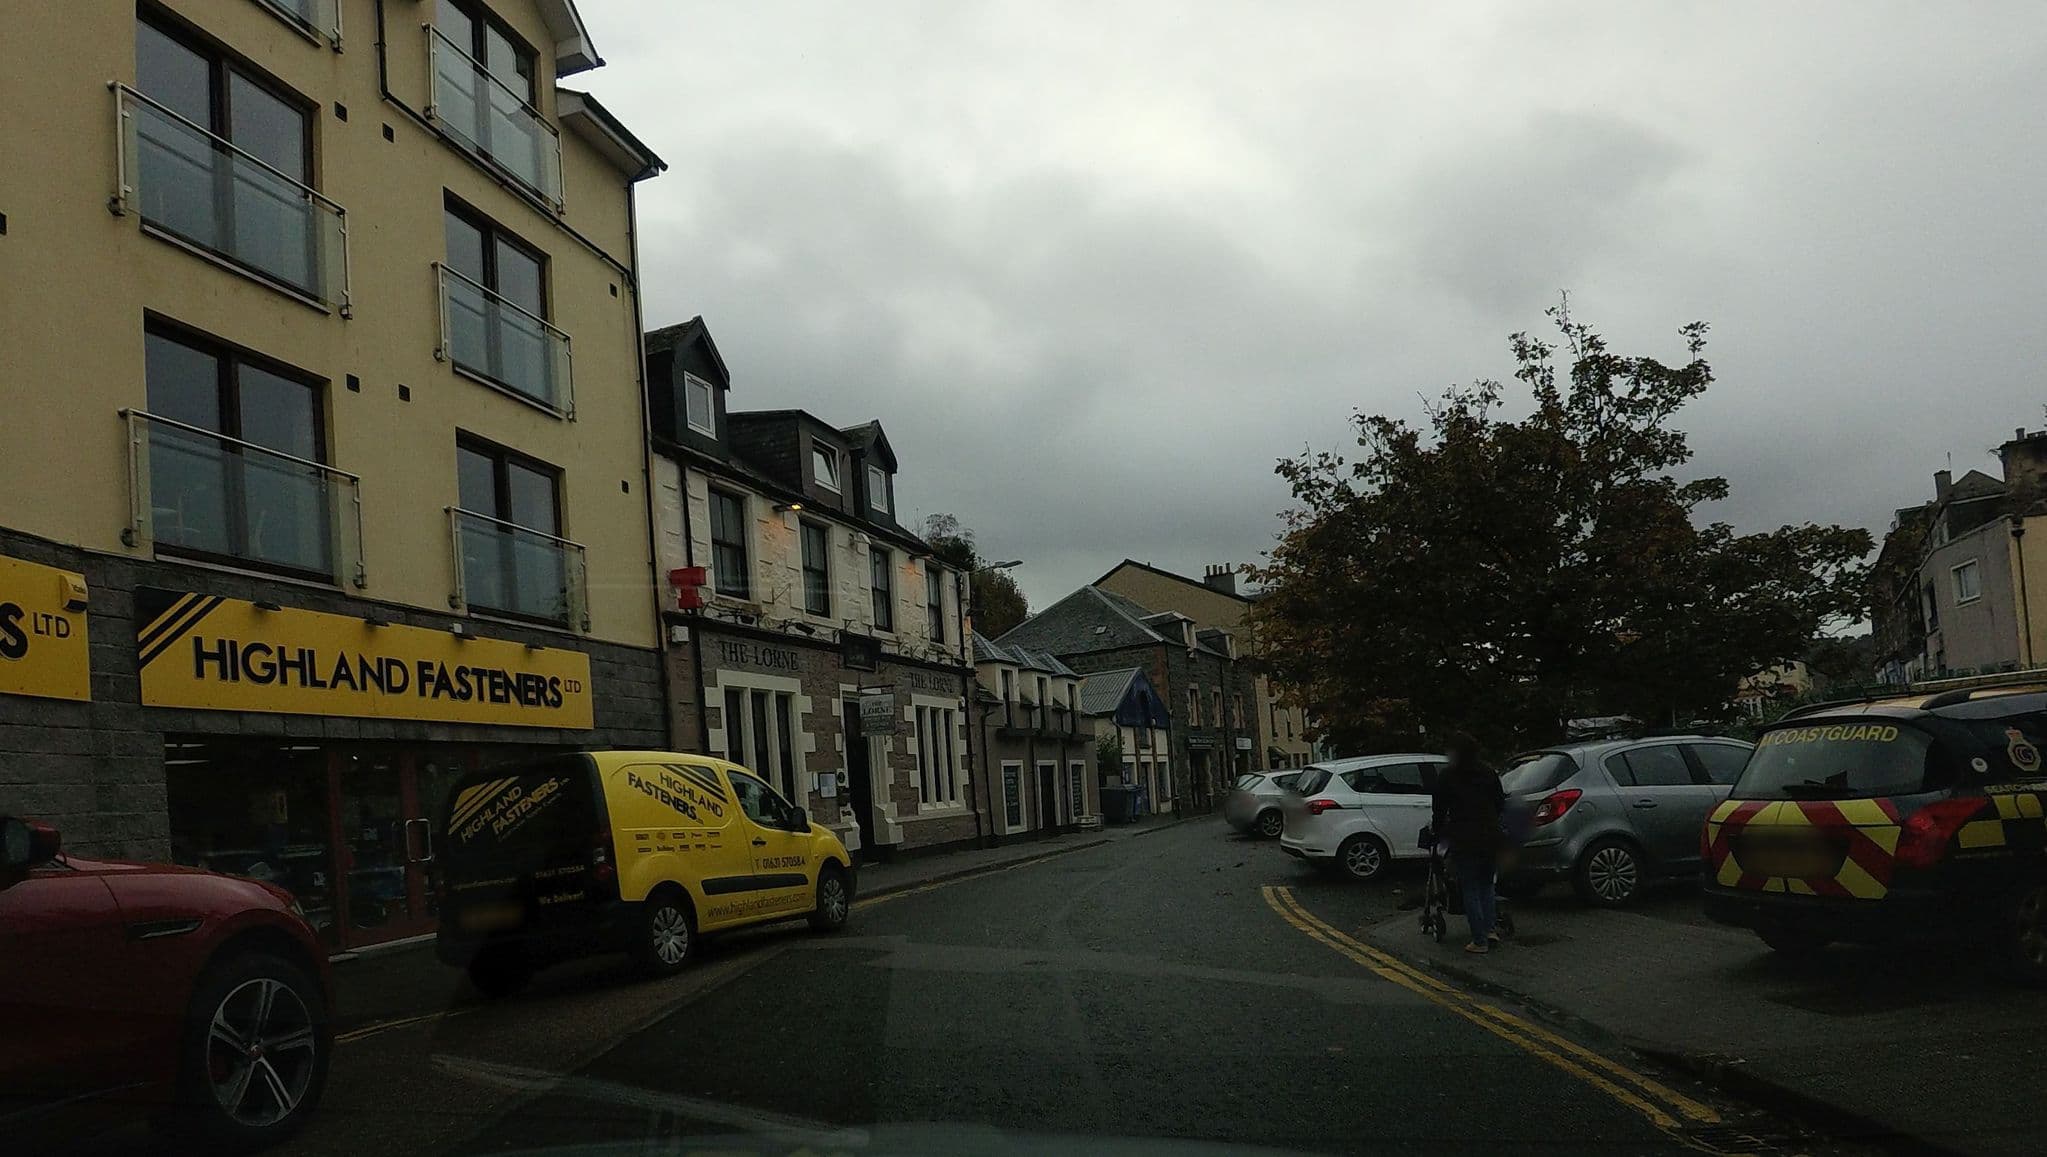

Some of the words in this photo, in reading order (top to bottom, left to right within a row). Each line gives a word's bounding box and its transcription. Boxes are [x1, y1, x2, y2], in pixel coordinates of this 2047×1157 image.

[33, 612, 70, 638] LTD
[193, 636, 409, 695] HIGHLAND
[417, 660, 563, 708] FASTENERS
[564, 679, 582, 693] LTD
[719, 641, 748, 664] THE
[754, 646, 799, 671] LORNE
[1774, 725, 1899, 746] COASTGUARD
[459, 785, 523, 843] HIGHLAND
[492, 776, 560, 836] FASTENERS
[628, 772, 697, 821] FASTENERS
[660, 771, 724, 819] HIGHLAND
